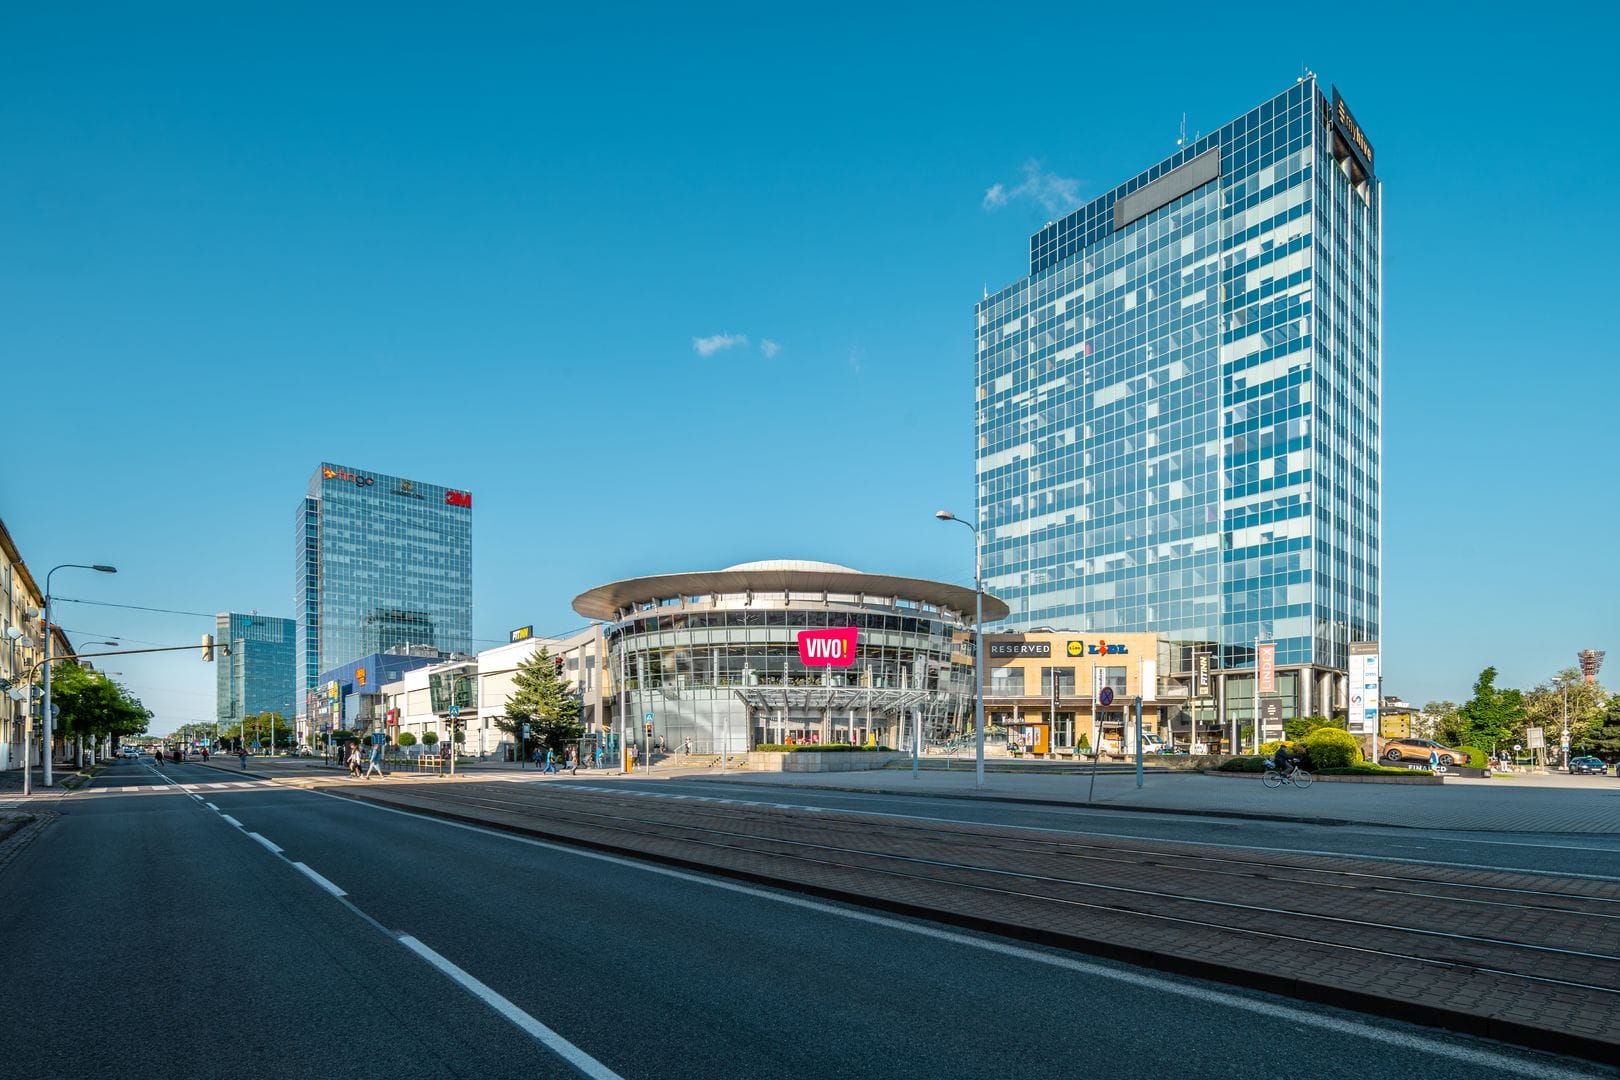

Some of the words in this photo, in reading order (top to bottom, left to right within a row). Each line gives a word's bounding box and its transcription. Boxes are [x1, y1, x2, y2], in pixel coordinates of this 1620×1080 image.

[444, 487, 472, 508] 3M
[806, 638, 848, 659] VIVO!
[991, 645, 1050, 653] RESERVED
[1200, 656, 1208, 686] FITINN
